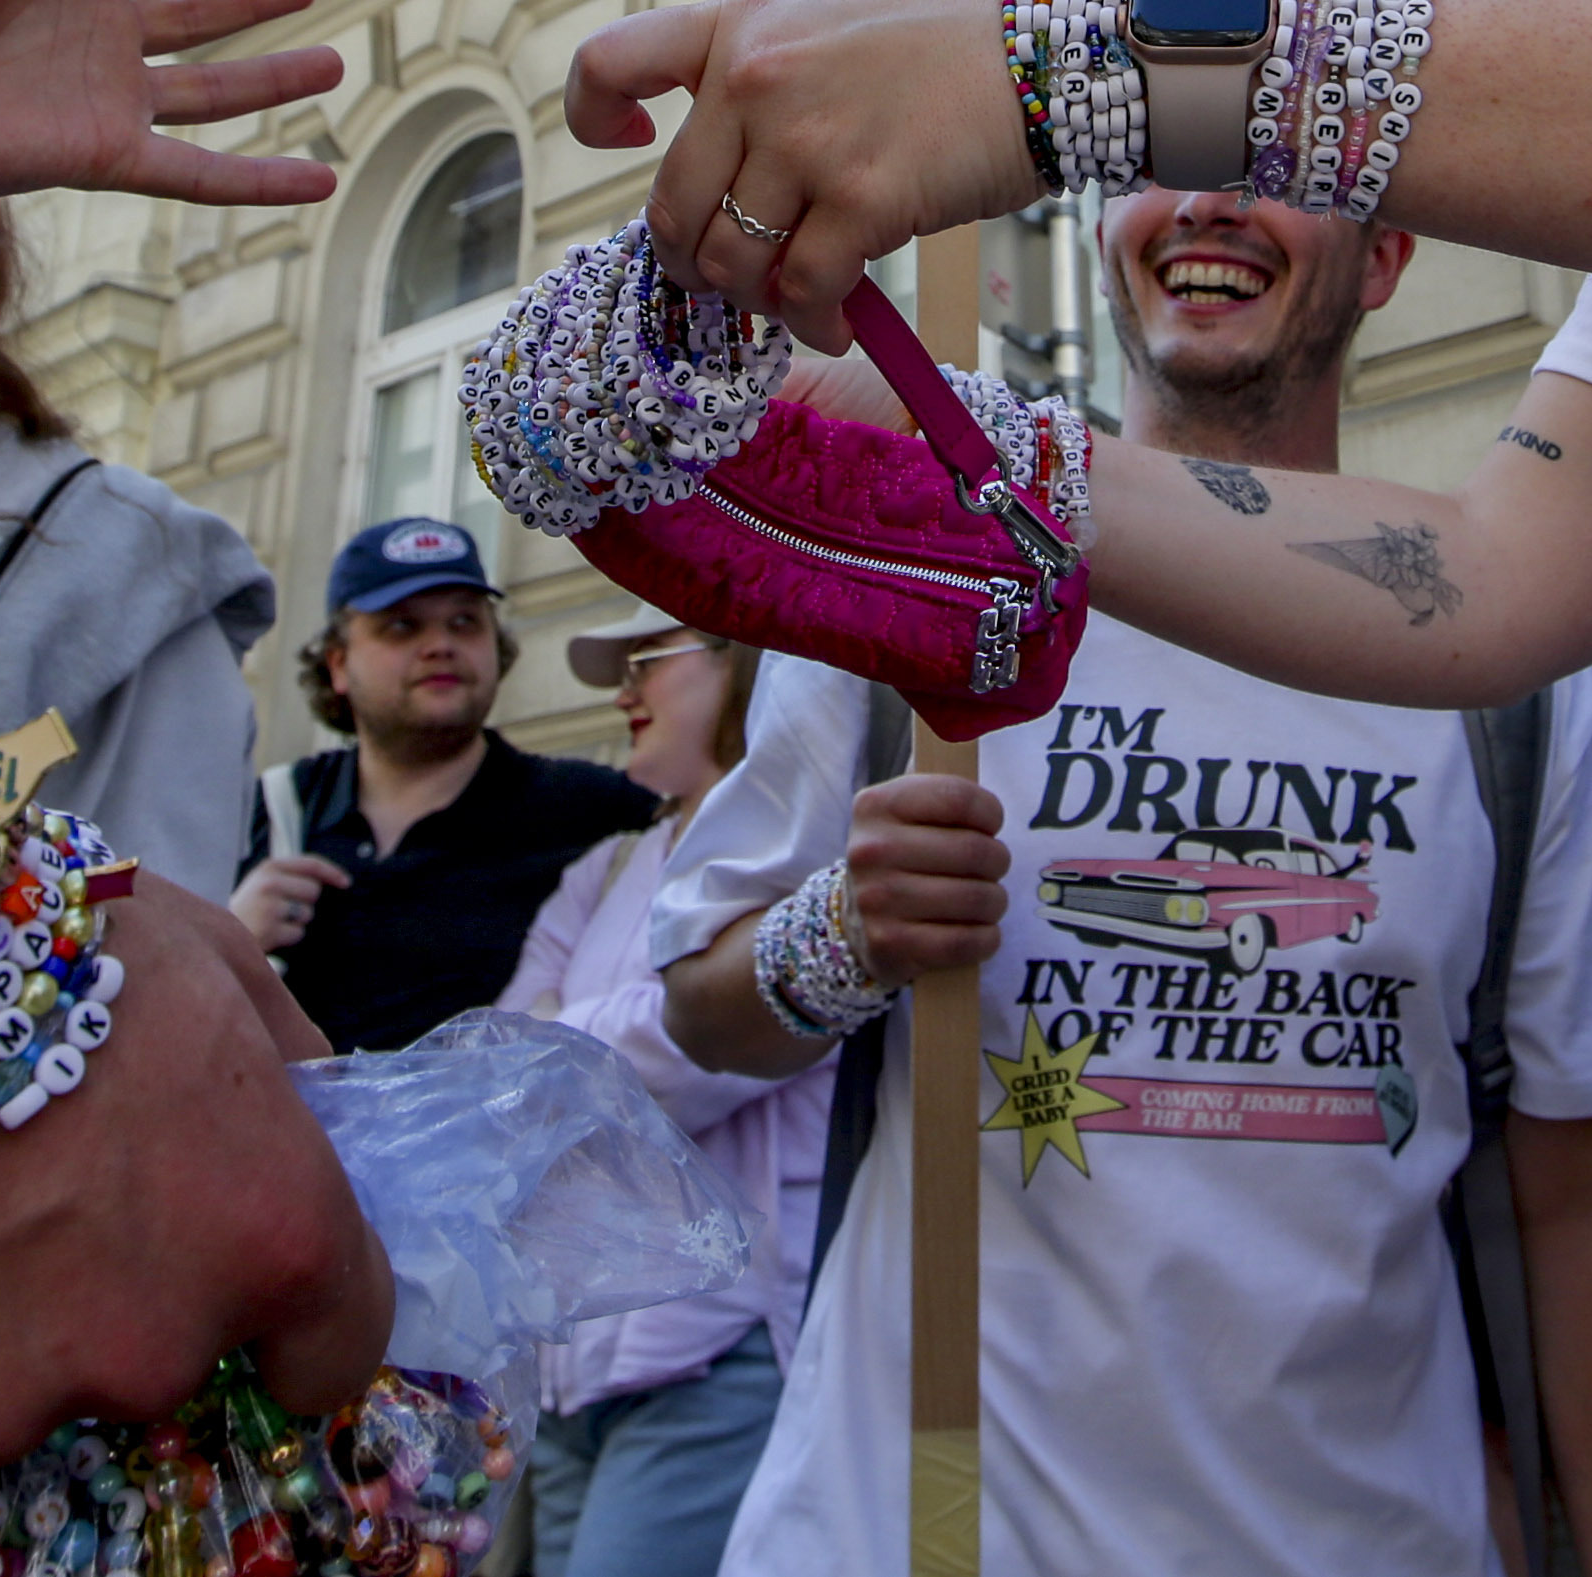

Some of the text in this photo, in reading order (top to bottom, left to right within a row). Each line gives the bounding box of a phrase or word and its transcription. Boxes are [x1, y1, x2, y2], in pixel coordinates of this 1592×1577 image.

[1512, 428, 1563, 462] KIND
[1047, 704, 1166, 752] I'M
[1028, 751, 1418, 853] DRUNK
[1015, 959, 1416, 1021] IN THE BACK
[1047, 1010, 1404, 1069] OF THE CAR
[1011, 1069, 1071, 1094] CRIED
[1013, 1088, 1076, 1113] LIKE A
[1141, 1088, 1234, 1110] COMING
[1241, 1092, 1312, 1115] HOME
[1315, 1095, 1376, 1117] FROM
[1020, 1105, 1071, 1129] BABY
[1141, 1110, 1244, 1132] THE BAR
